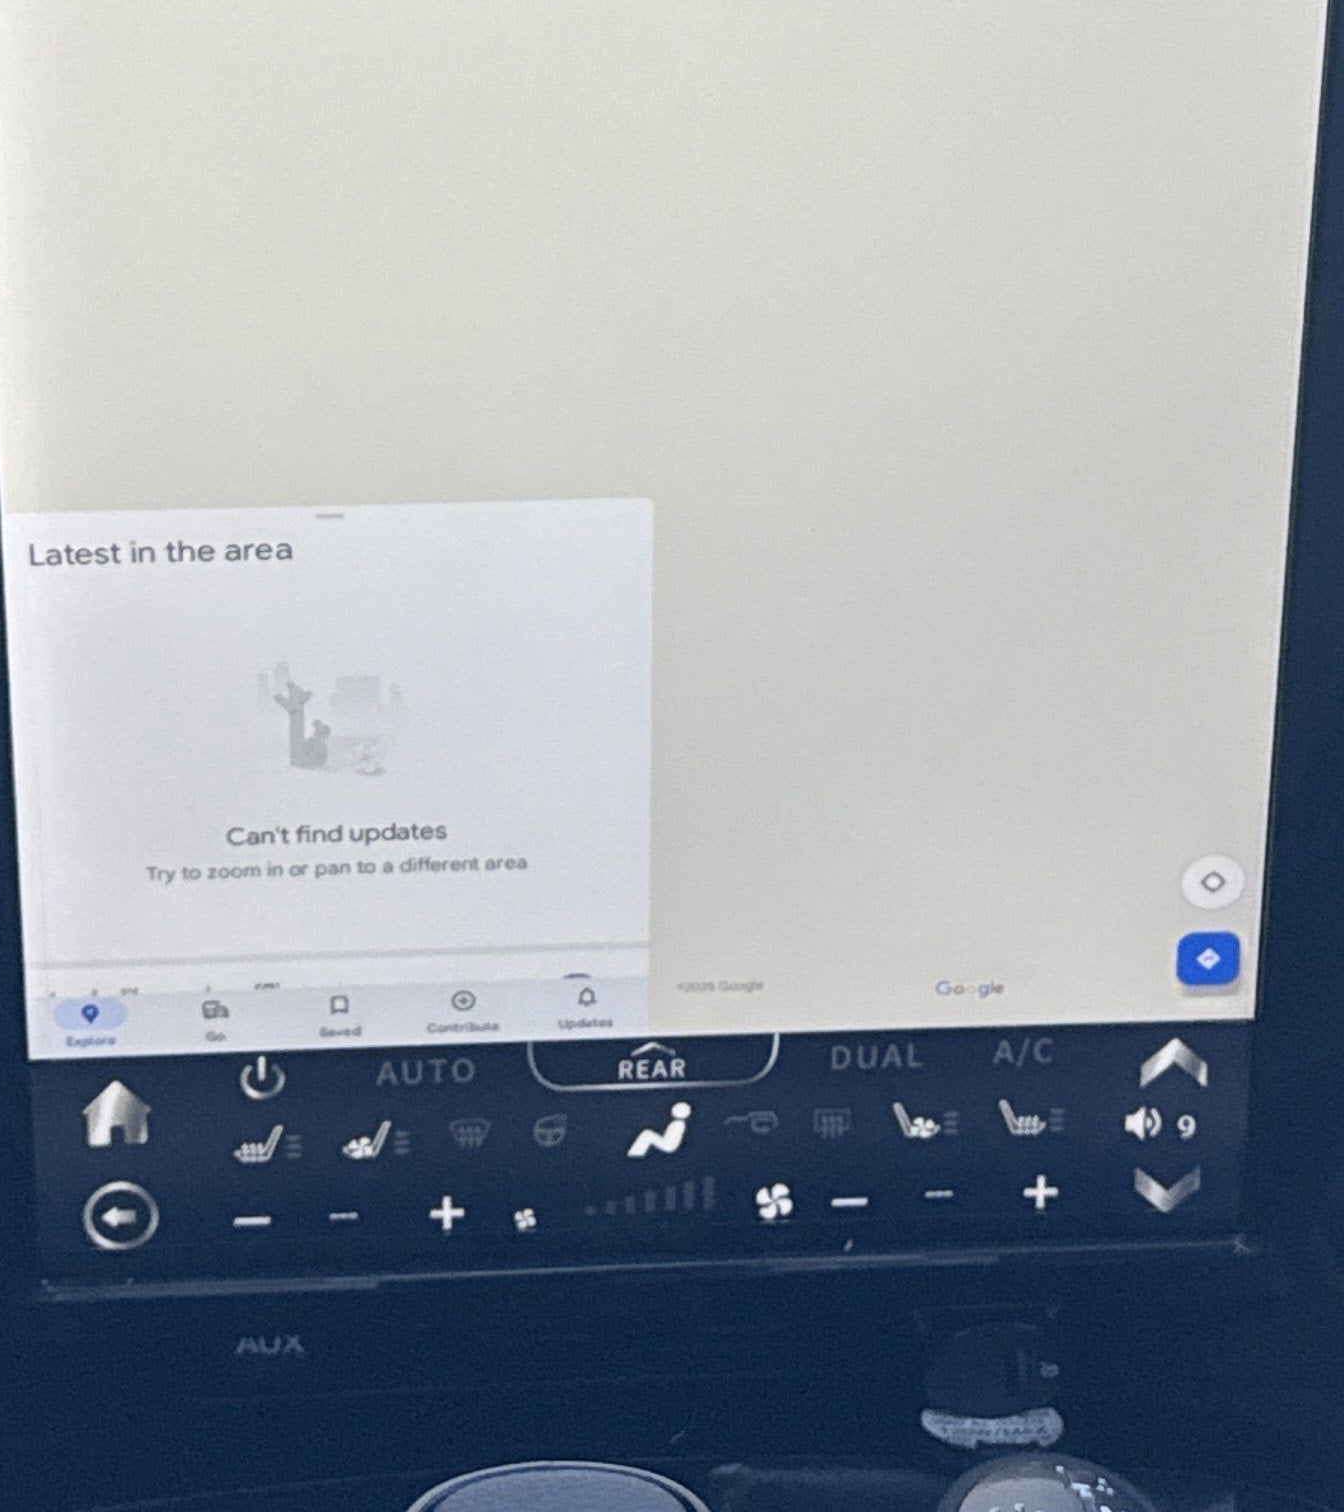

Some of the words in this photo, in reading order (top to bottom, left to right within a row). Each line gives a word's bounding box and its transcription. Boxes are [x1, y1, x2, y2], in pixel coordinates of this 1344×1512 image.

[28, 543, 121, 566] Latest
[129, 540, 156, 563] in
[165, 540, 215, 562] the
[224, 542, 293, 561] area
[226, 826, 290, 846] Can't
[296, 824, 343, 843] find
[349, 823, 448, 846] updates
[146, 866, 176, 885] Try
[182, 867, 202, 880] to
[207, 865, 262, 880] zoom
[267, 860, 284, 877] in
[289, 864, 309, 877] or
[315, 862, 351, 879] pan
[357, 860, 376, 874] to
[382, 861, 394, 874] a
[399, 856, 480, 873] different
[485, 857, 528, 871] area
[426, 1022, 500, 1034] Contribute
[558, 1018, 614, 1030] Updates
[830, 1043, 922, 1070] DUAL
[992, 1038, 1055, 1065] A/C
[376, 1058, 476, 1087] AUTO
[618, 1058, 685, 1080] REAR
[1177, 1114, 1196, 1140] 9
[237, 1335, 304, 1355] AUX
